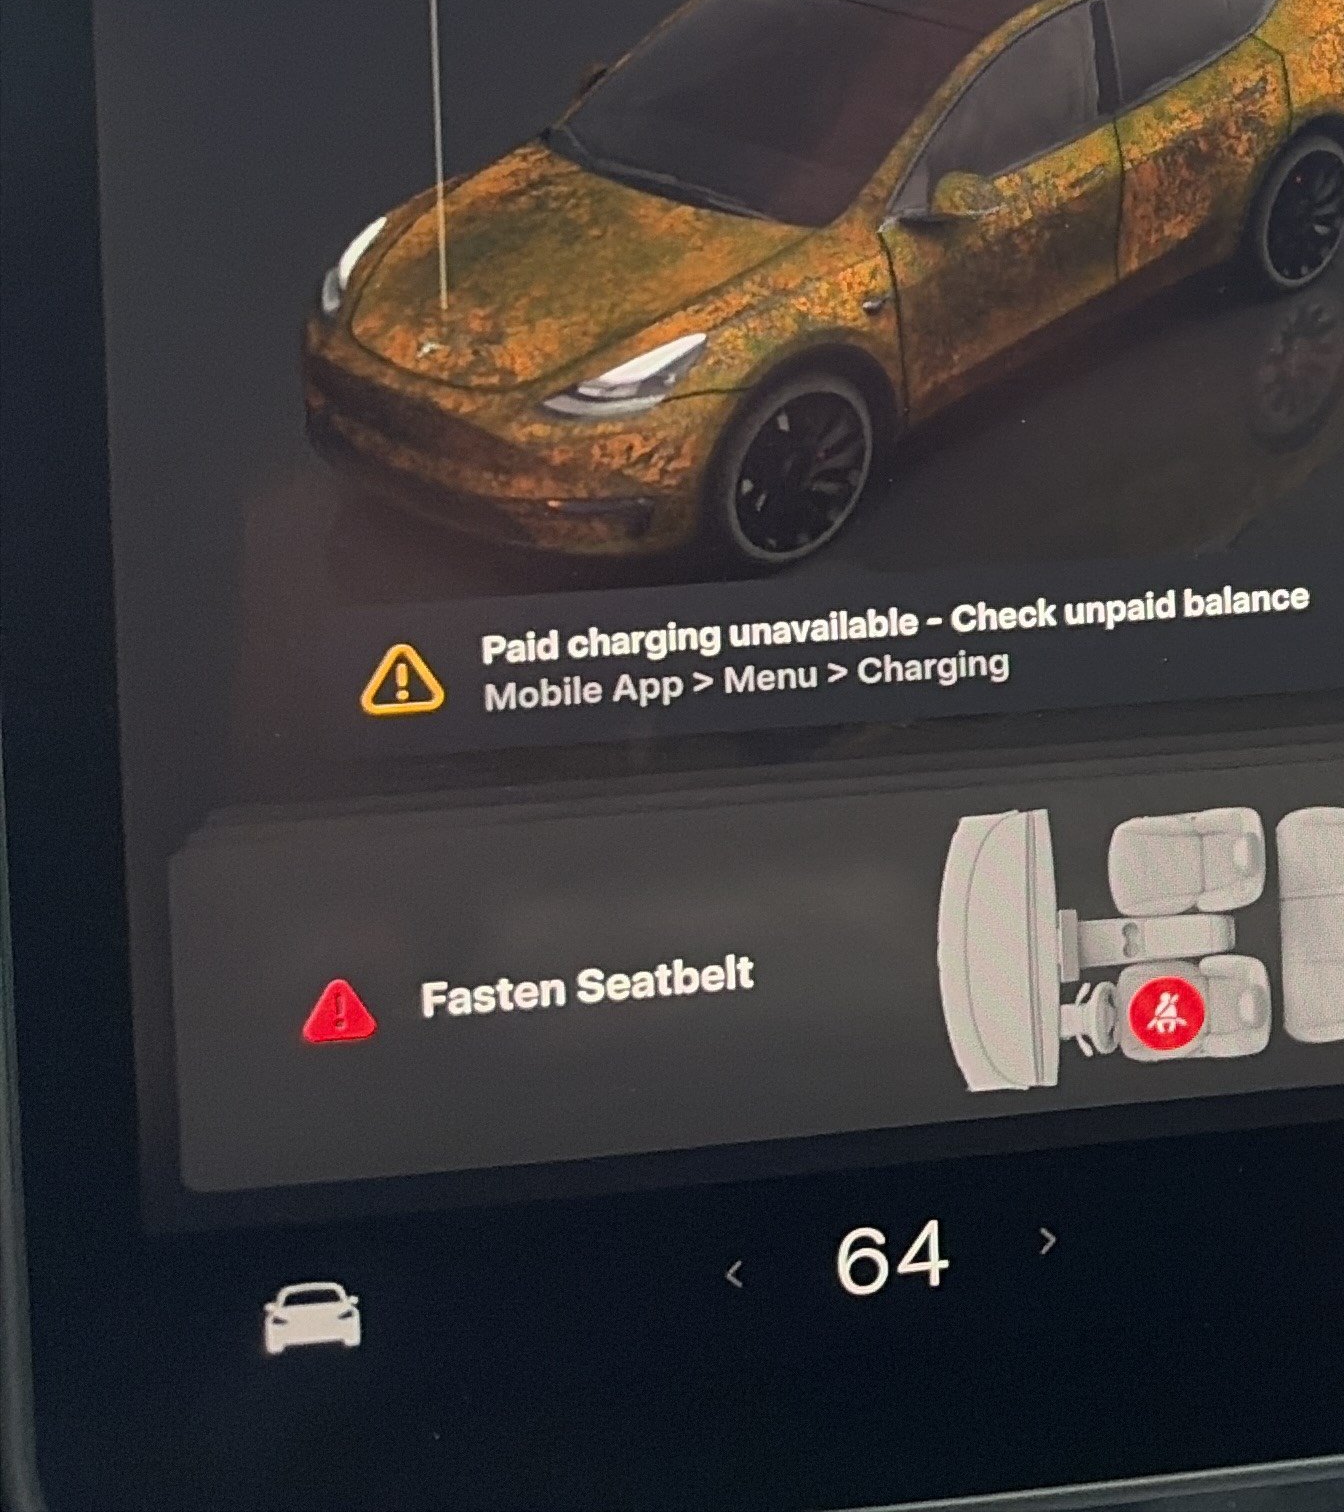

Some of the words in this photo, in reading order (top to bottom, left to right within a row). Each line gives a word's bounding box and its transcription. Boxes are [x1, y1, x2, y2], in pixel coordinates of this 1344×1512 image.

[481, 629, 560, 666] Paid
[566, 621, 722, 661] charging
[728, 606, 920, 648] unavailable
[950, 597, 1058, 633] Check
[1063, 589, 1177, 630] unpaid
[1183, 585, 1310, 617] balance
[484, 675, 603, 712] Mobile
[612, 673, 684, 707] App
[692, 671, 714, 692] >
[724, 665, 818, 694] Menu
[827, 662, 848, 683] >
[857, 649, 1010, 687] Charging
[421, 977, 567, 1019] Fasten
[576, 953, 755, 1004] Seatbelt
[837, 1219, 950, 1296] 64
